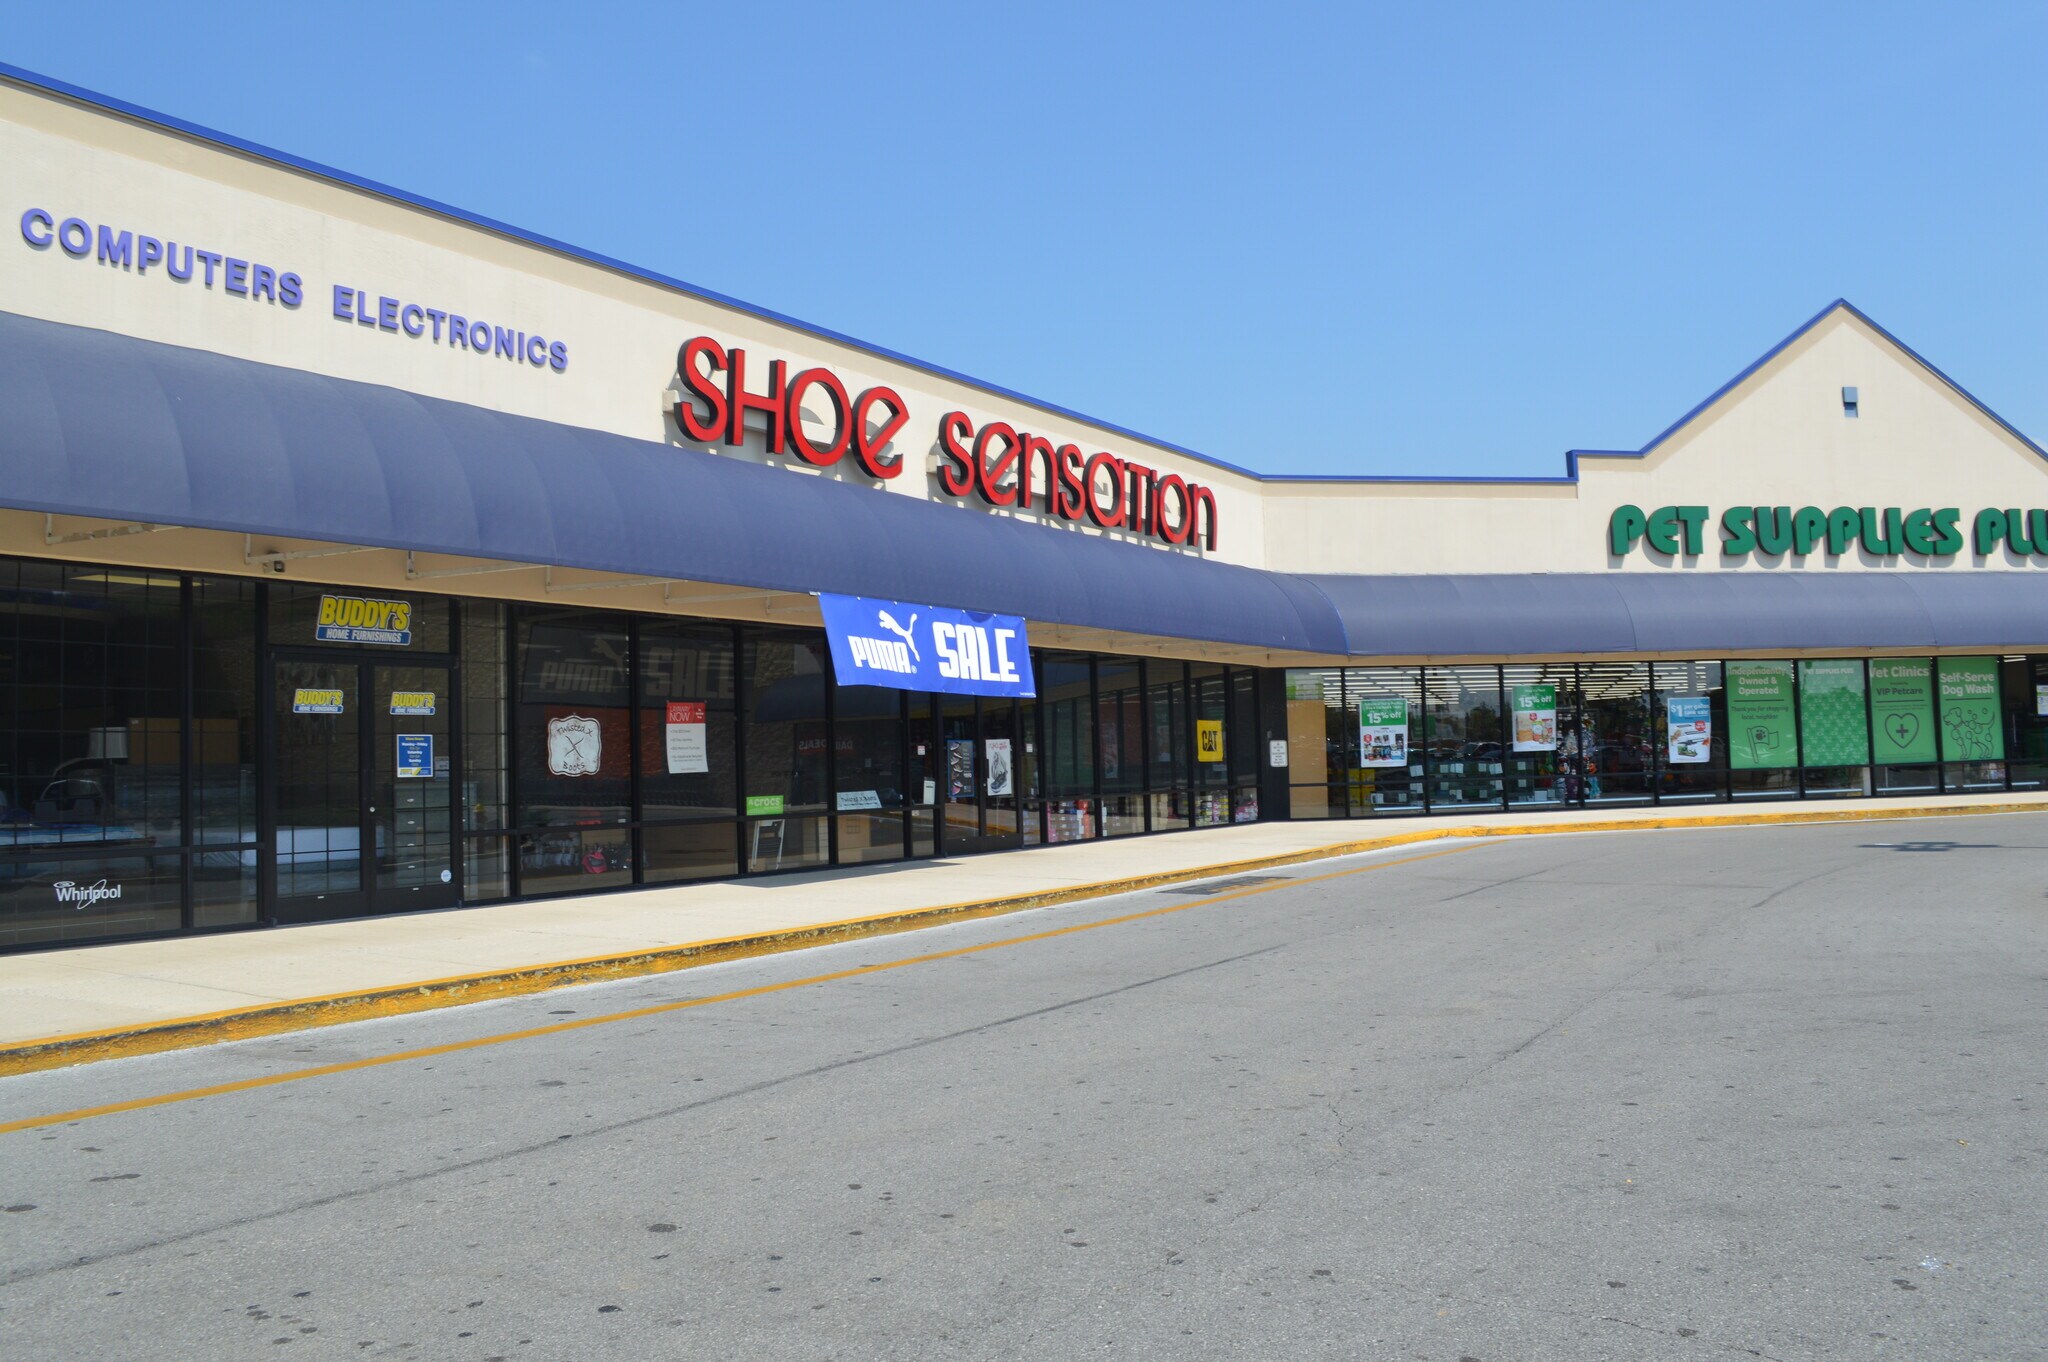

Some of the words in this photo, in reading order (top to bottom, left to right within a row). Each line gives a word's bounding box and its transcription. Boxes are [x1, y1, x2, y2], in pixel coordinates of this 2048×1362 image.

[21, 208, 303, 308] COMPUTERS
[332, 284, 570, 372] ELECTRONICS
[1610, 504, 1709, 555] PET
[1722, 506, 1963, 556] SUPPLIES
[319, 597, 410, 631] BUDDY'S
[326, 628, 349, 640] HOME
[351, 630, 402, 643] FURNISHINGS
[847, 635, 912, 674] PUMA
[932, 621, 1020, 683] SALE
[1728, 667, 1786, 677] Independently
[1869, 667, 1888, 678] Vet
[1890, 665, 1930, 677] Clinics
[1940, 672, 1995, 683] Self-Serve
[1738, 676, 1769, 685] Owned
[1770, 676, 1778, 685] &
[1738, 686, 1780, 697] Operated
[1876, 687, 1891, 696] VIP
[1892, 686, 1924, 695] Petcare
[1942, 684, 1964, 697] Dog
[1964, 683, 1995, 695] Wash
[296, 691, 342, 705] BUDDY'S
[392, 693, 434, 707] BUDDY'S
[1518, 695, 1540, 708] 15%
[1541, 695, 1552, 703] off
[669, 711, 691, 722] NOW
[1367, 710, 1390, 724] 15%
[1390, 711, 1402, 719] off
[1670, 704, 1683, 717] $1
[556, 724, 586, 735] Twisted
[1201, 729, 1218, 752] CAT
[563, 760, 586, 772] Boots
[754, 797, 780, 807] crocs
[55, 883, 121, 905] Whirlpool
